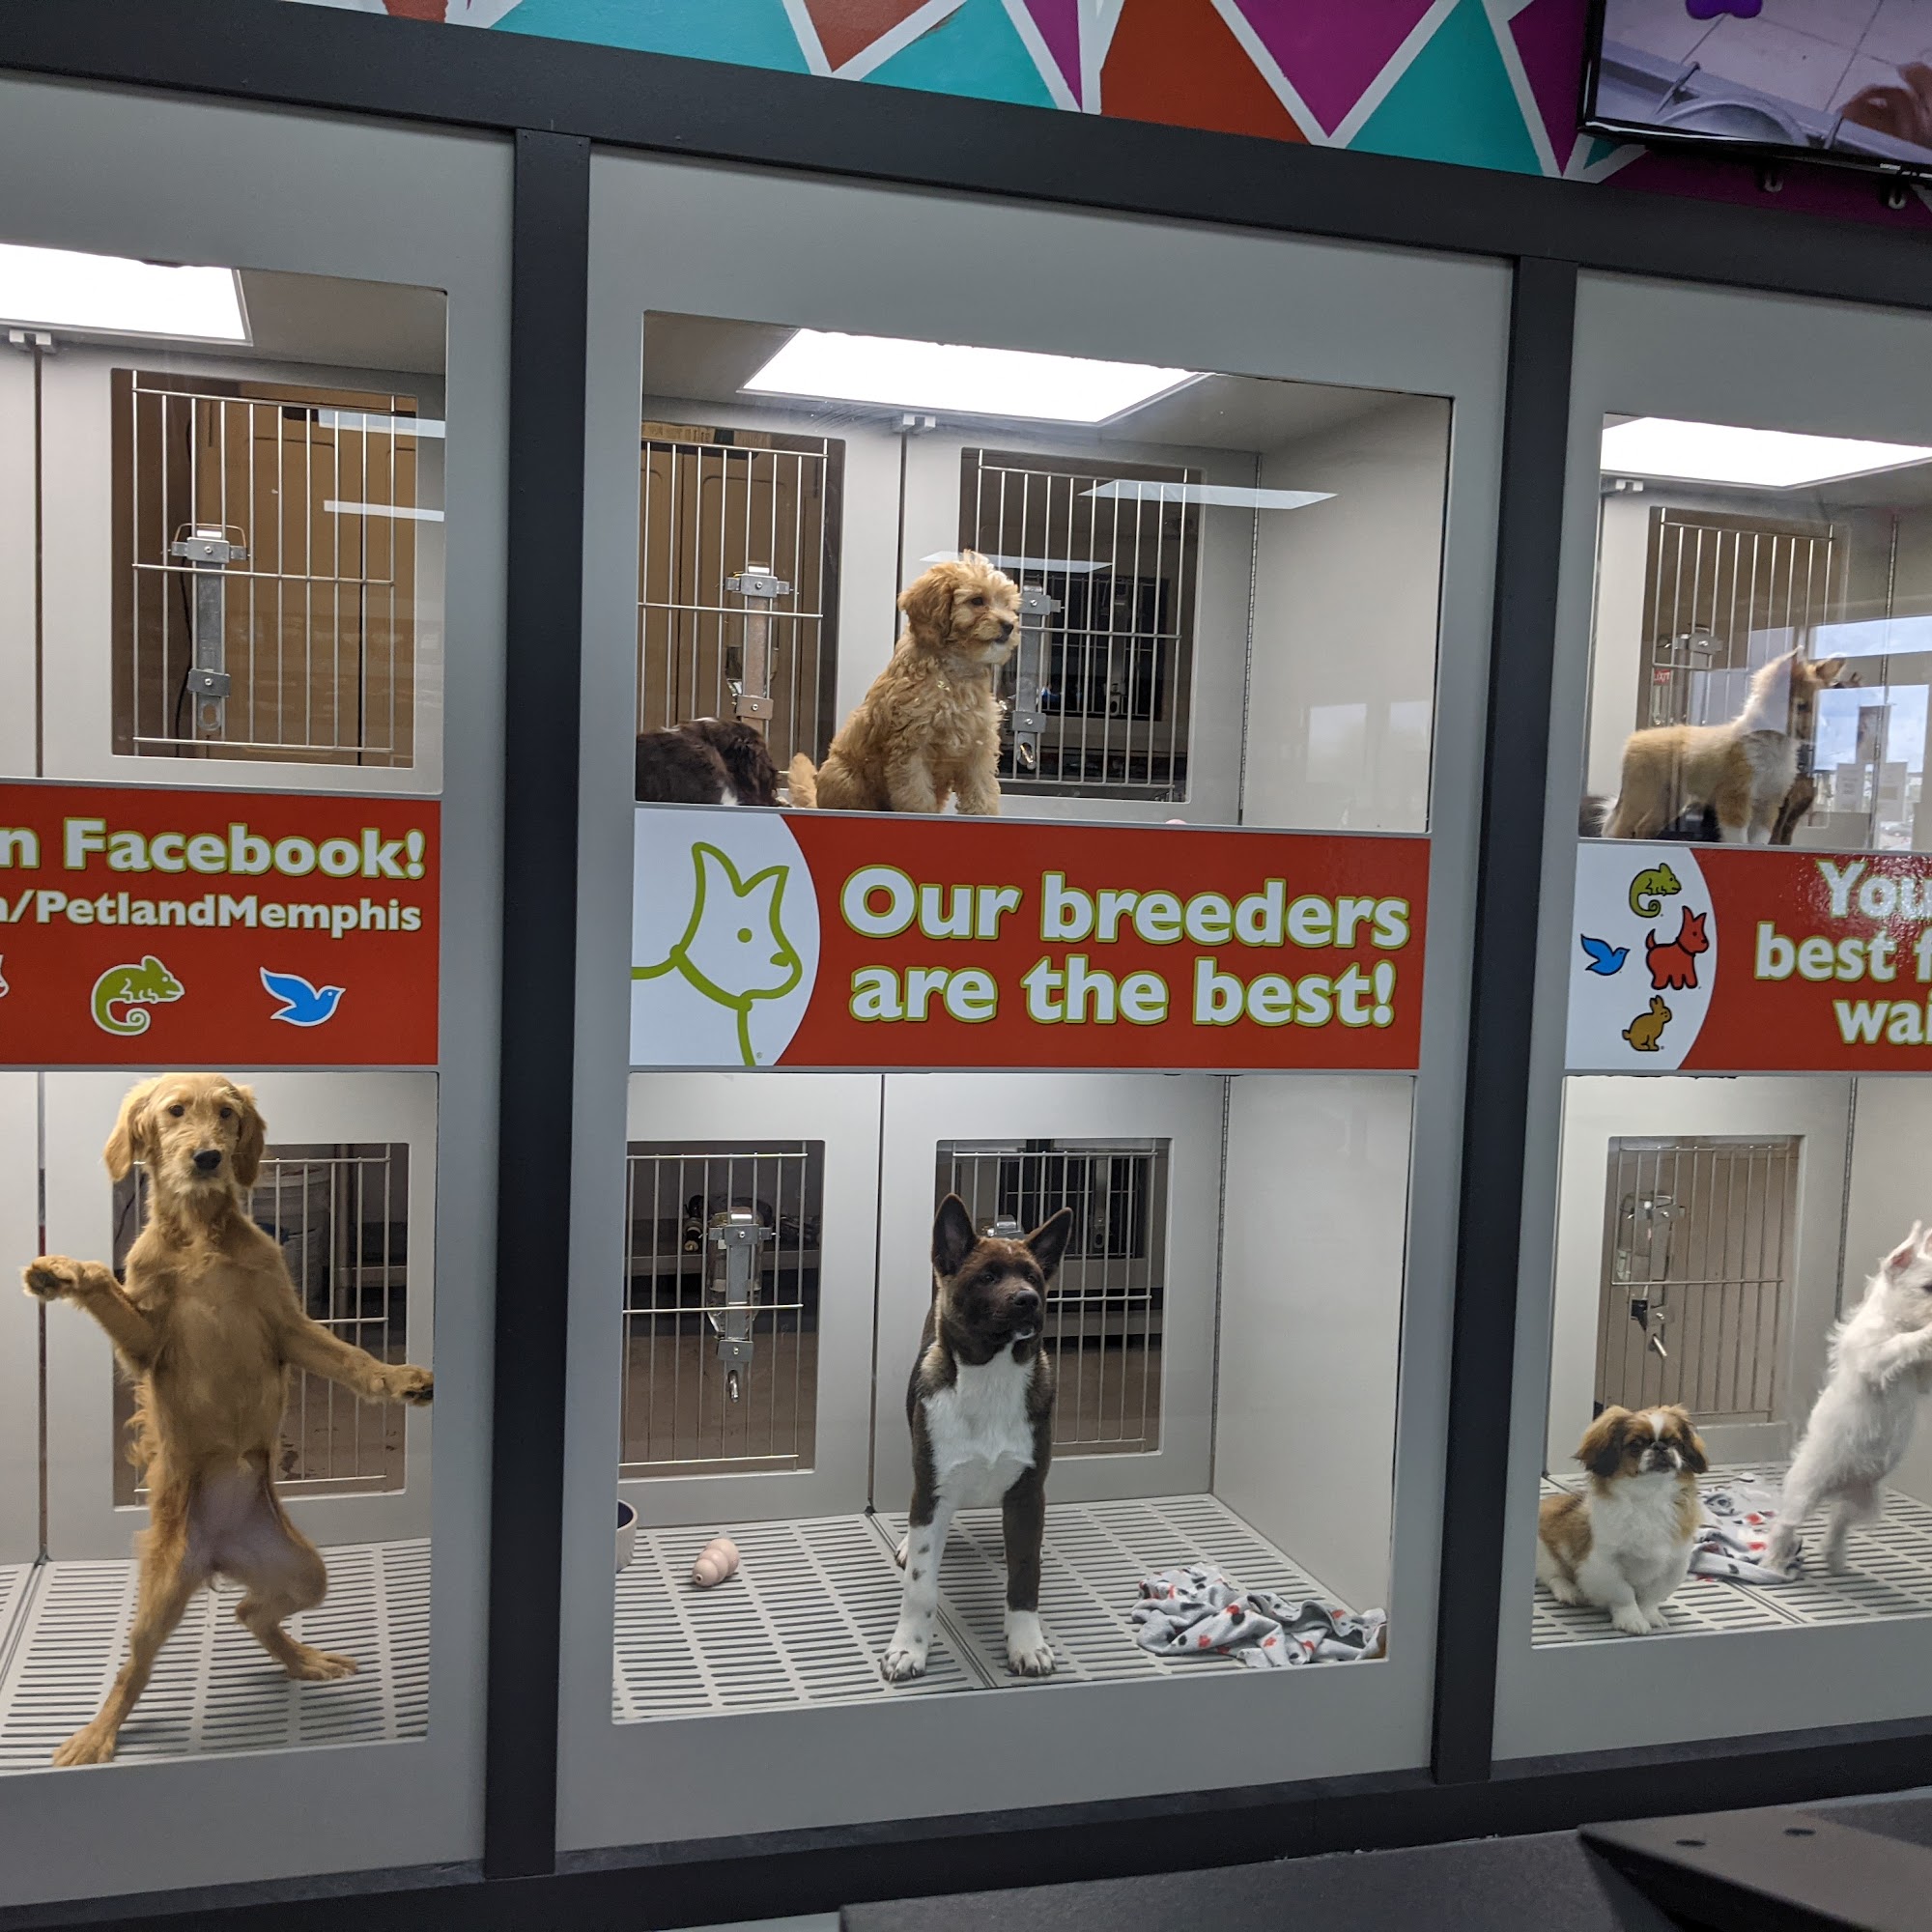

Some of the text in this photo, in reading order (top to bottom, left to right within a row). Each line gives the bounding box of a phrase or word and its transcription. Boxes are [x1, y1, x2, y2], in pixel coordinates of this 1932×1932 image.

[64, 817, 425, 879] Facebook!
[0, 889, 421, 938] /PetlandMemphis
[839, 865, 1409, 950] Our breeders
[1817, 860, 1932, 920] You
[1754, 922, 1897, 981] best
[848, 953, 1396, 1028] are the best!
